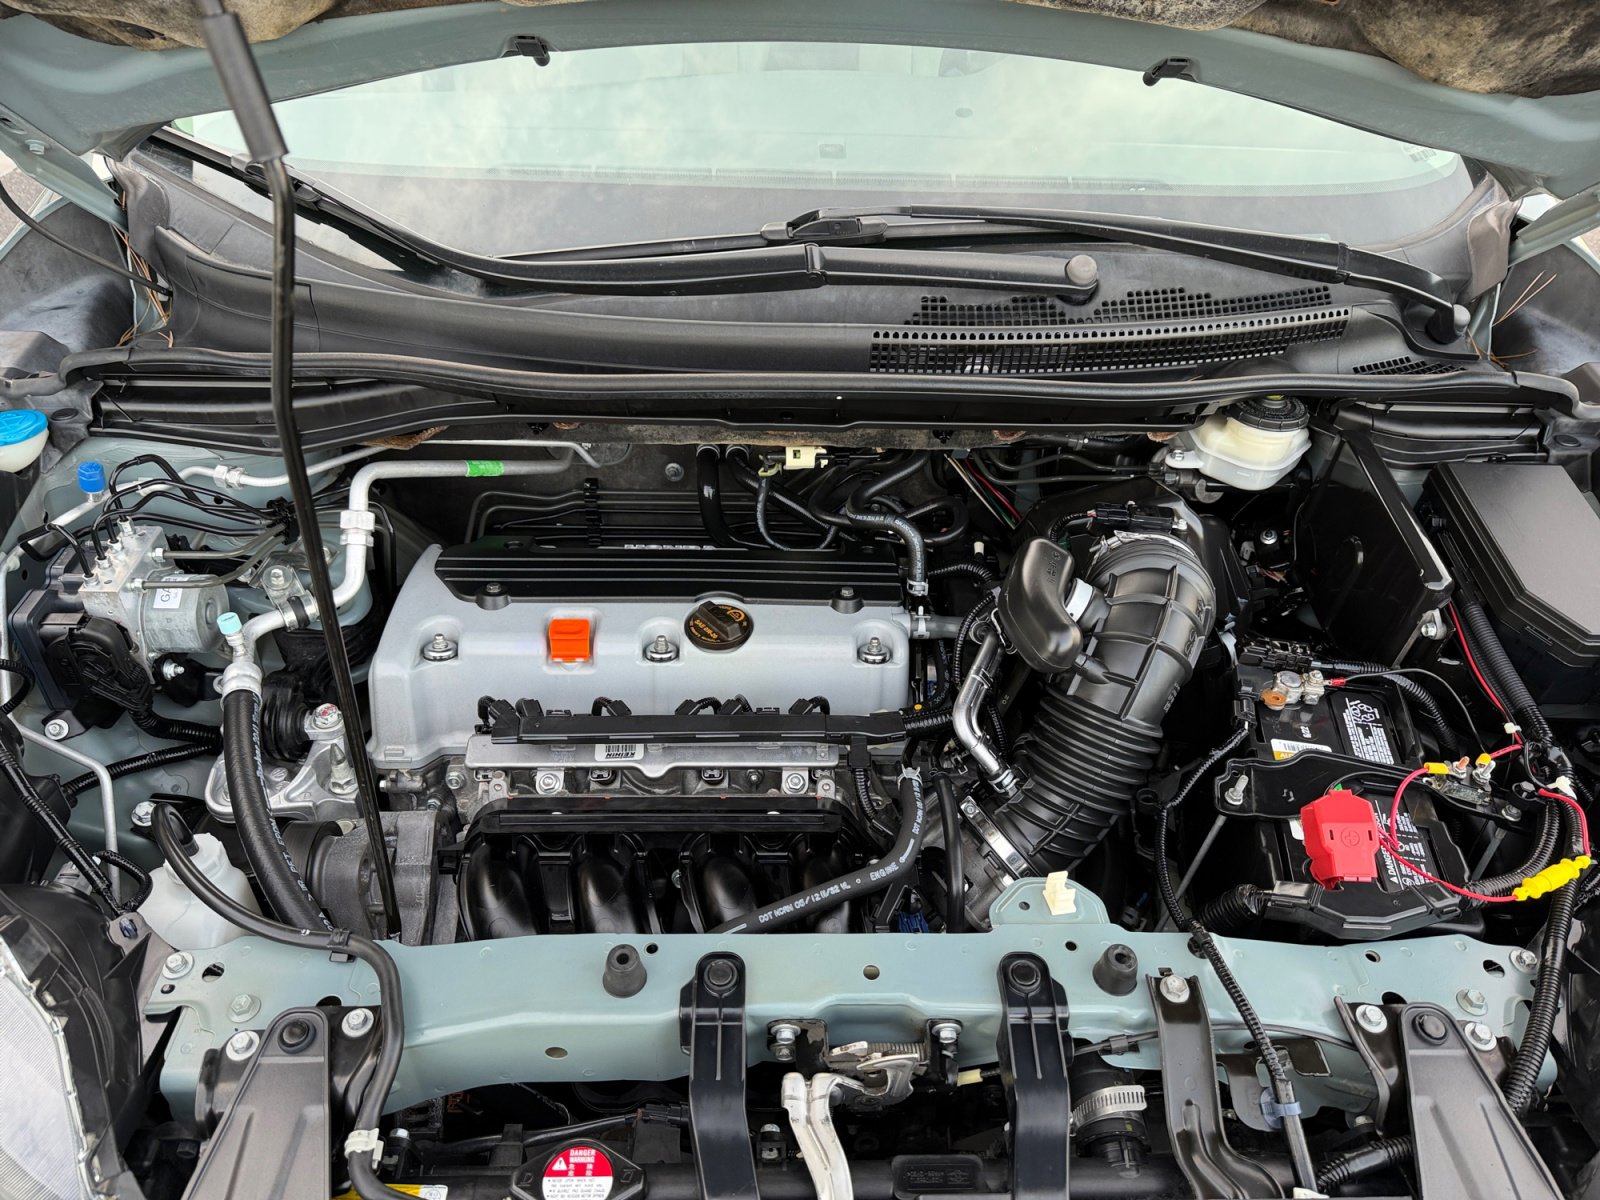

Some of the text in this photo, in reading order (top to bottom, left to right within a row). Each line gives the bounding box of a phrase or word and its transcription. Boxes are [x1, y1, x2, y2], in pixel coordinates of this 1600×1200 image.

[869, 861, 899, 881] ENGINE
[758, 911, 773, 923] DOT
[569, 1148, 596, 1156] DANGER
